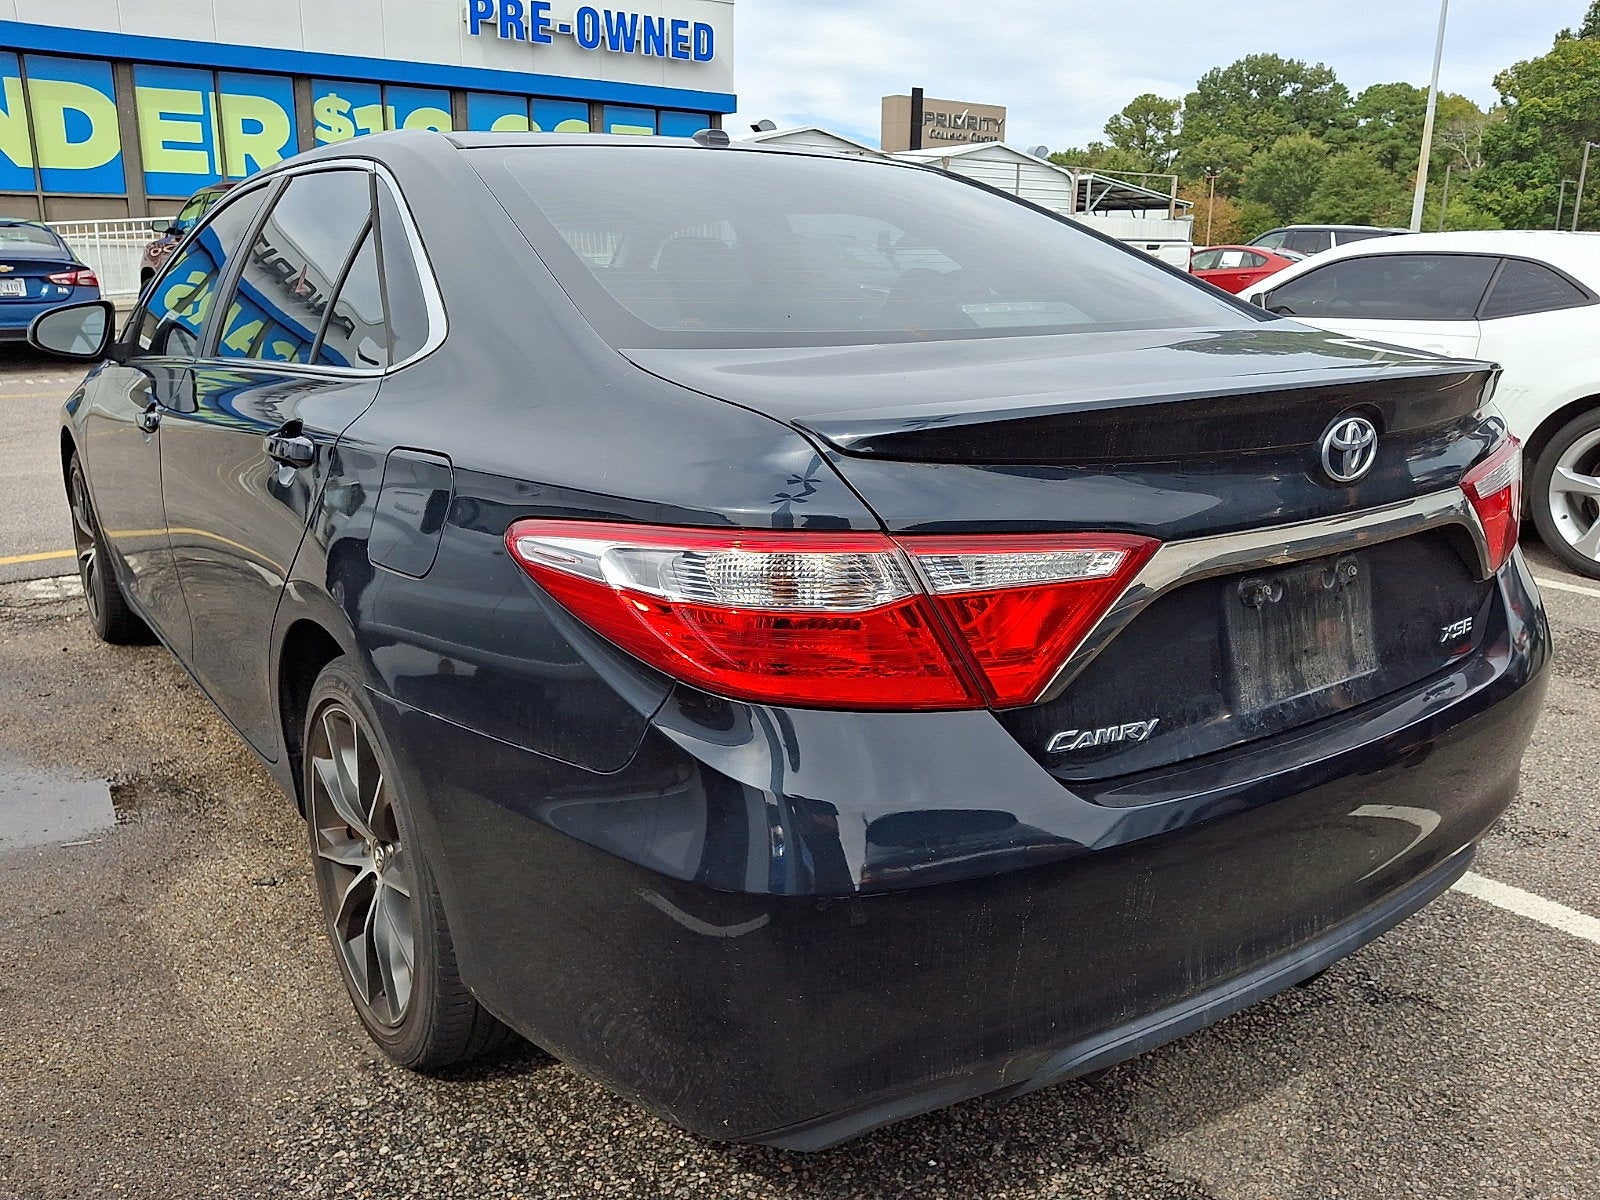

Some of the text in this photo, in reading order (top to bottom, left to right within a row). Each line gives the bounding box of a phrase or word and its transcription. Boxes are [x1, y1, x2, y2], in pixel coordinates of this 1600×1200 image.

[467, 0, 715, 62] PRE-OWNED
[923, 109, 1004, 133] PRIORITY
[1440, 616, 1473, 642] XSE
[1046, 718, 1160, 754] CAMRY
